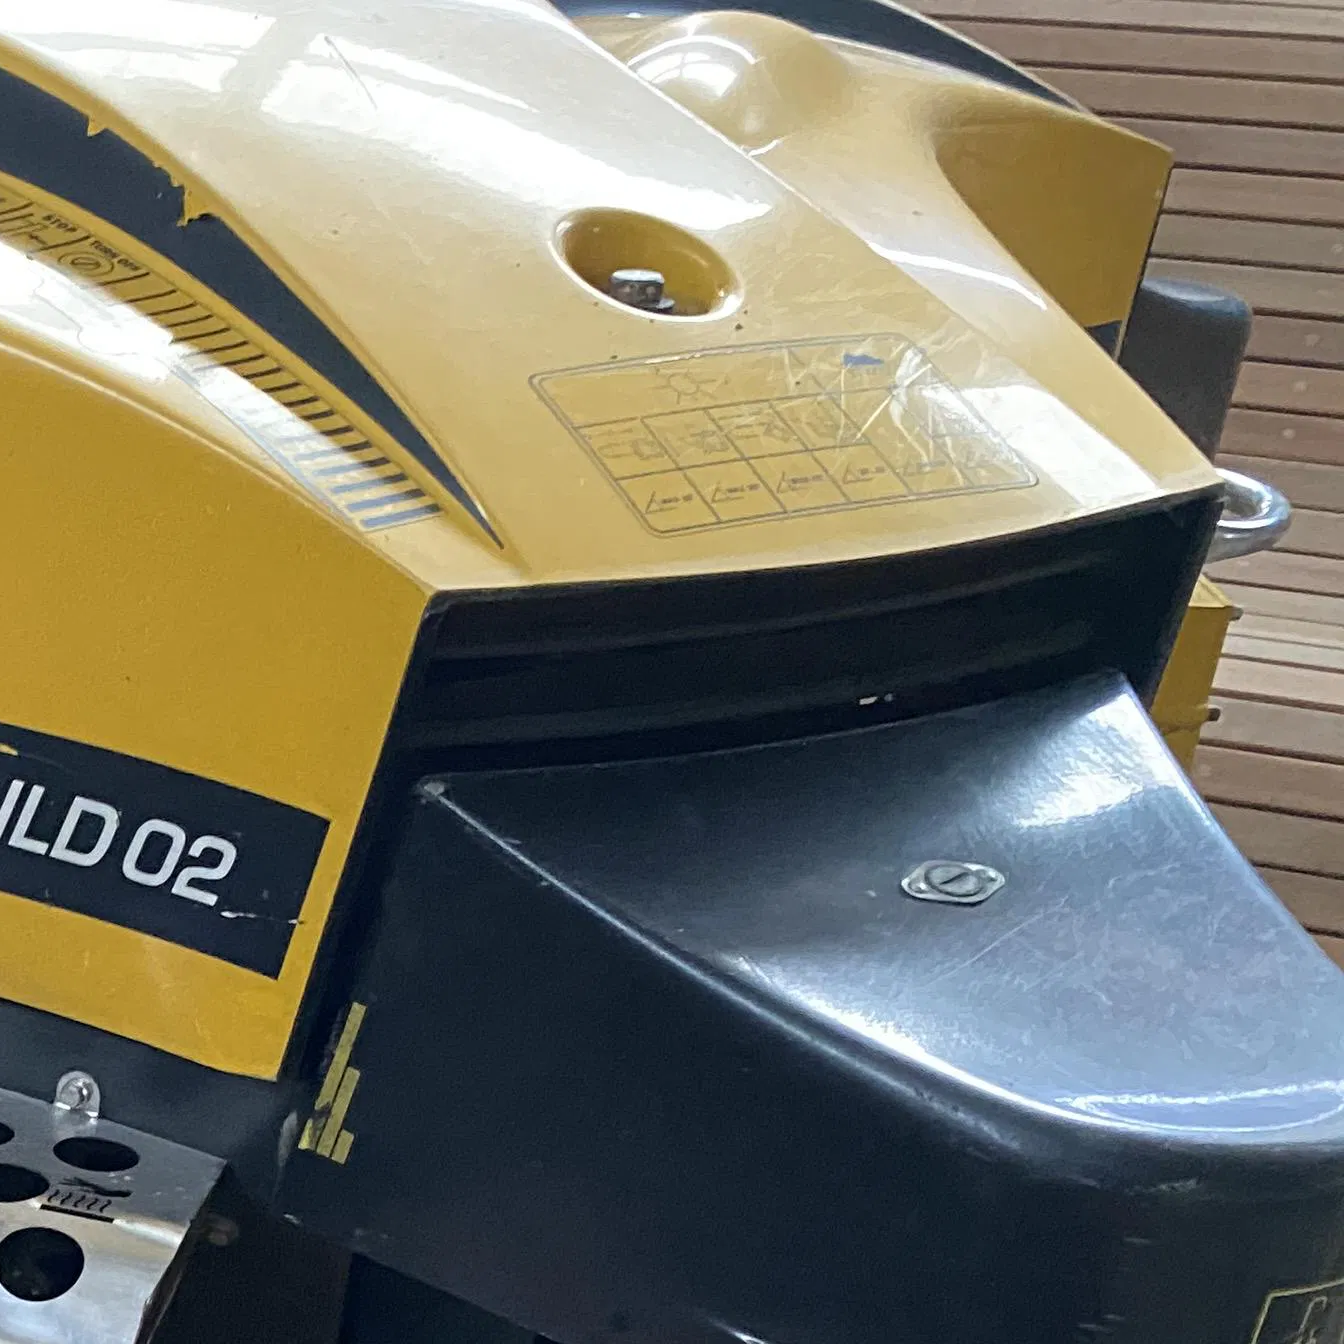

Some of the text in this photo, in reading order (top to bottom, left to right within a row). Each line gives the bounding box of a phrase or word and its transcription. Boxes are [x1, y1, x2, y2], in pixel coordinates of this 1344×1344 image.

[42, 214, 78, 233] STOP
[90, 239, 119, 260] TURN
[122, 818, 238, 907] 02
